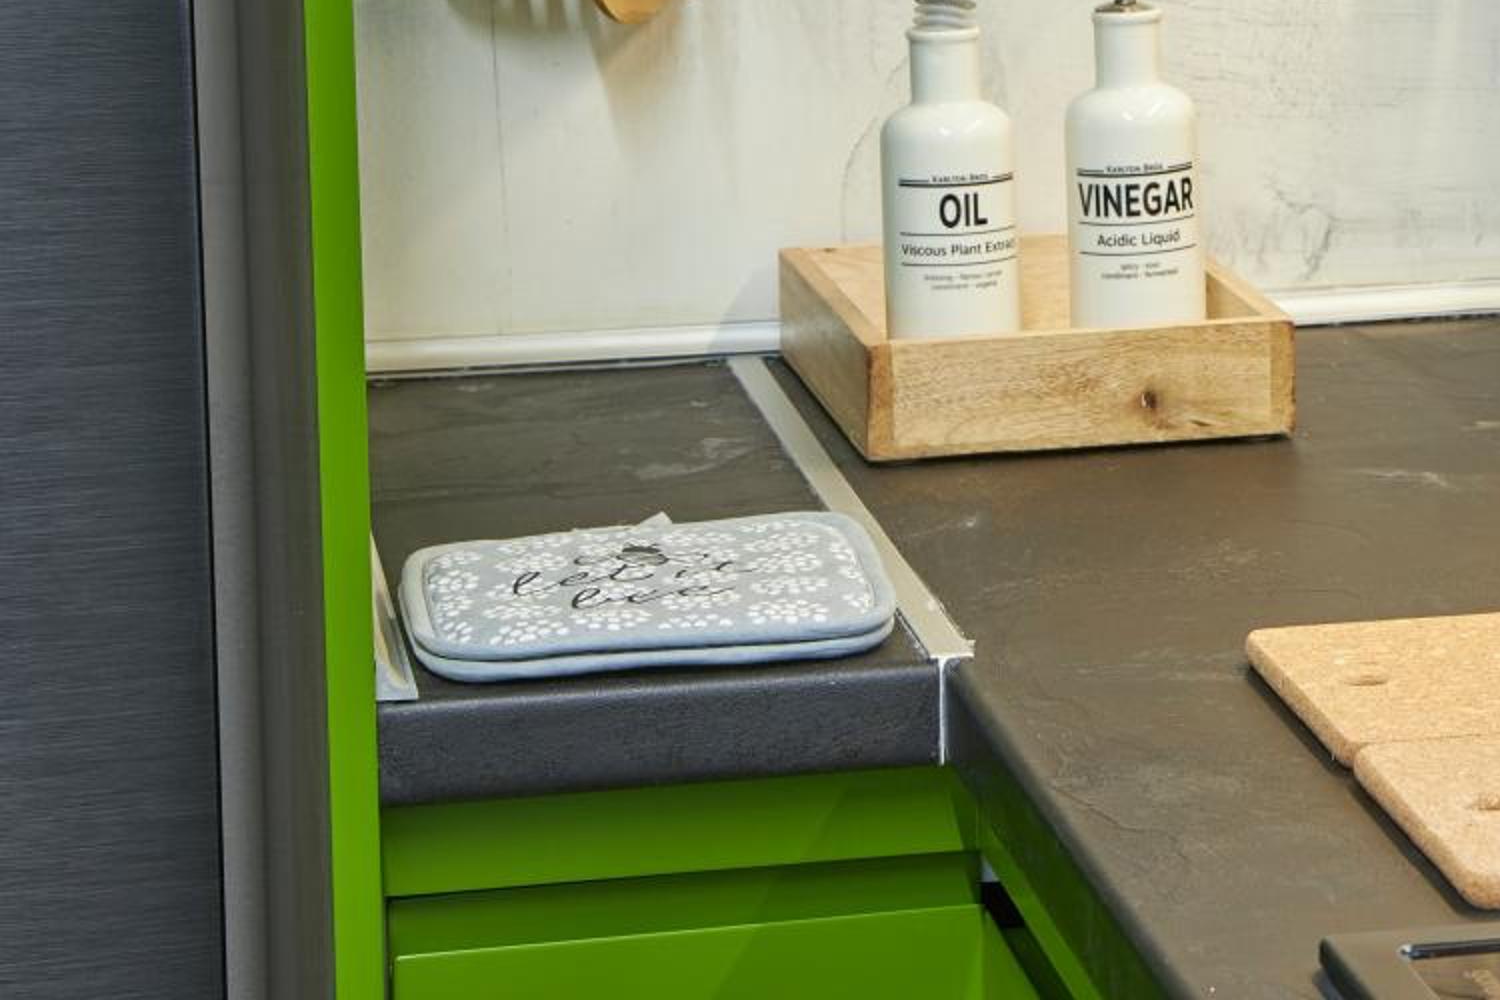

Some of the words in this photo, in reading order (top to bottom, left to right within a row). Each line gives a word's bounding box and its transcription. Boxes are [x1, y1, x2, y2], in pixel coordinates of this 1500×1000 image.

[939, 192, 989, 228] OIL
[1078, 176, 1194, 217] VINEGAR
[901, 243, 948, 257] Viscous
[951, 242, 982, 256] Plant
[1097, 234, 1138, 248] Acidic
[1141, 228, 1181, 247] Liquid
